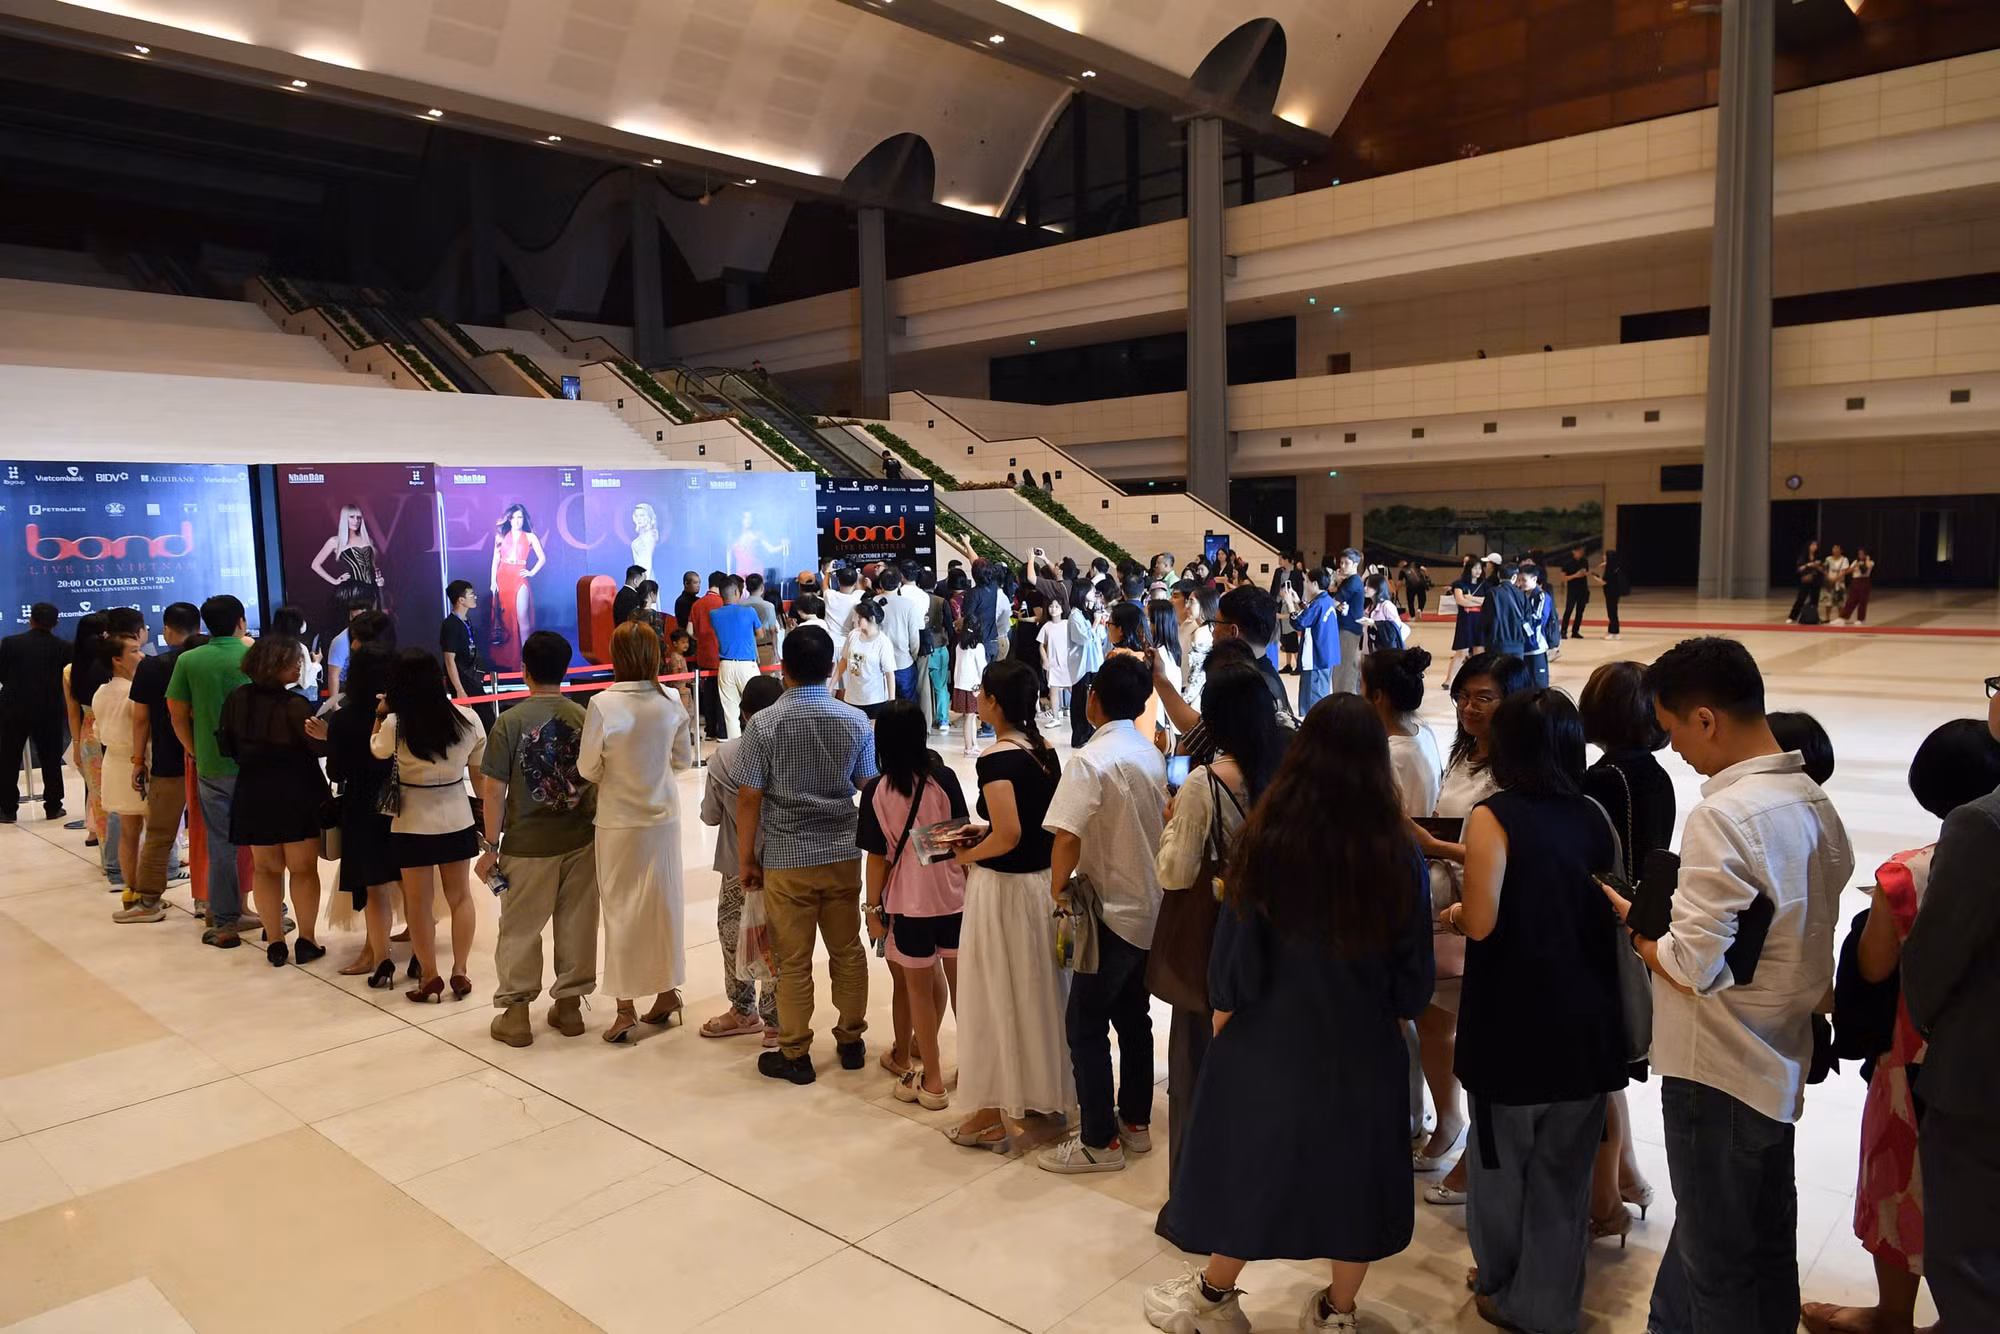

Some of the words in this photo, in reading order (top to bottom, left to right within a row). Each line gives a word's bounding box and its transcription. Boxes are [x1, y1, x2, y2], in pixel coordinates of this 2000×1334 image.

[96, 473, 120, 482] BIDV
[834, 516, 905, 542] bond
[25, 521, 193, 561] bond
[29, 565, 74, 576] LIVE
[86, 564, 105, 573] IN
[116, 562, 197, 572] VIETNAM
[57, 580, 81, 588] 20:00
[85, 578, 139, 587] OCTOBER
[155, 576, 175, 584] 2024
